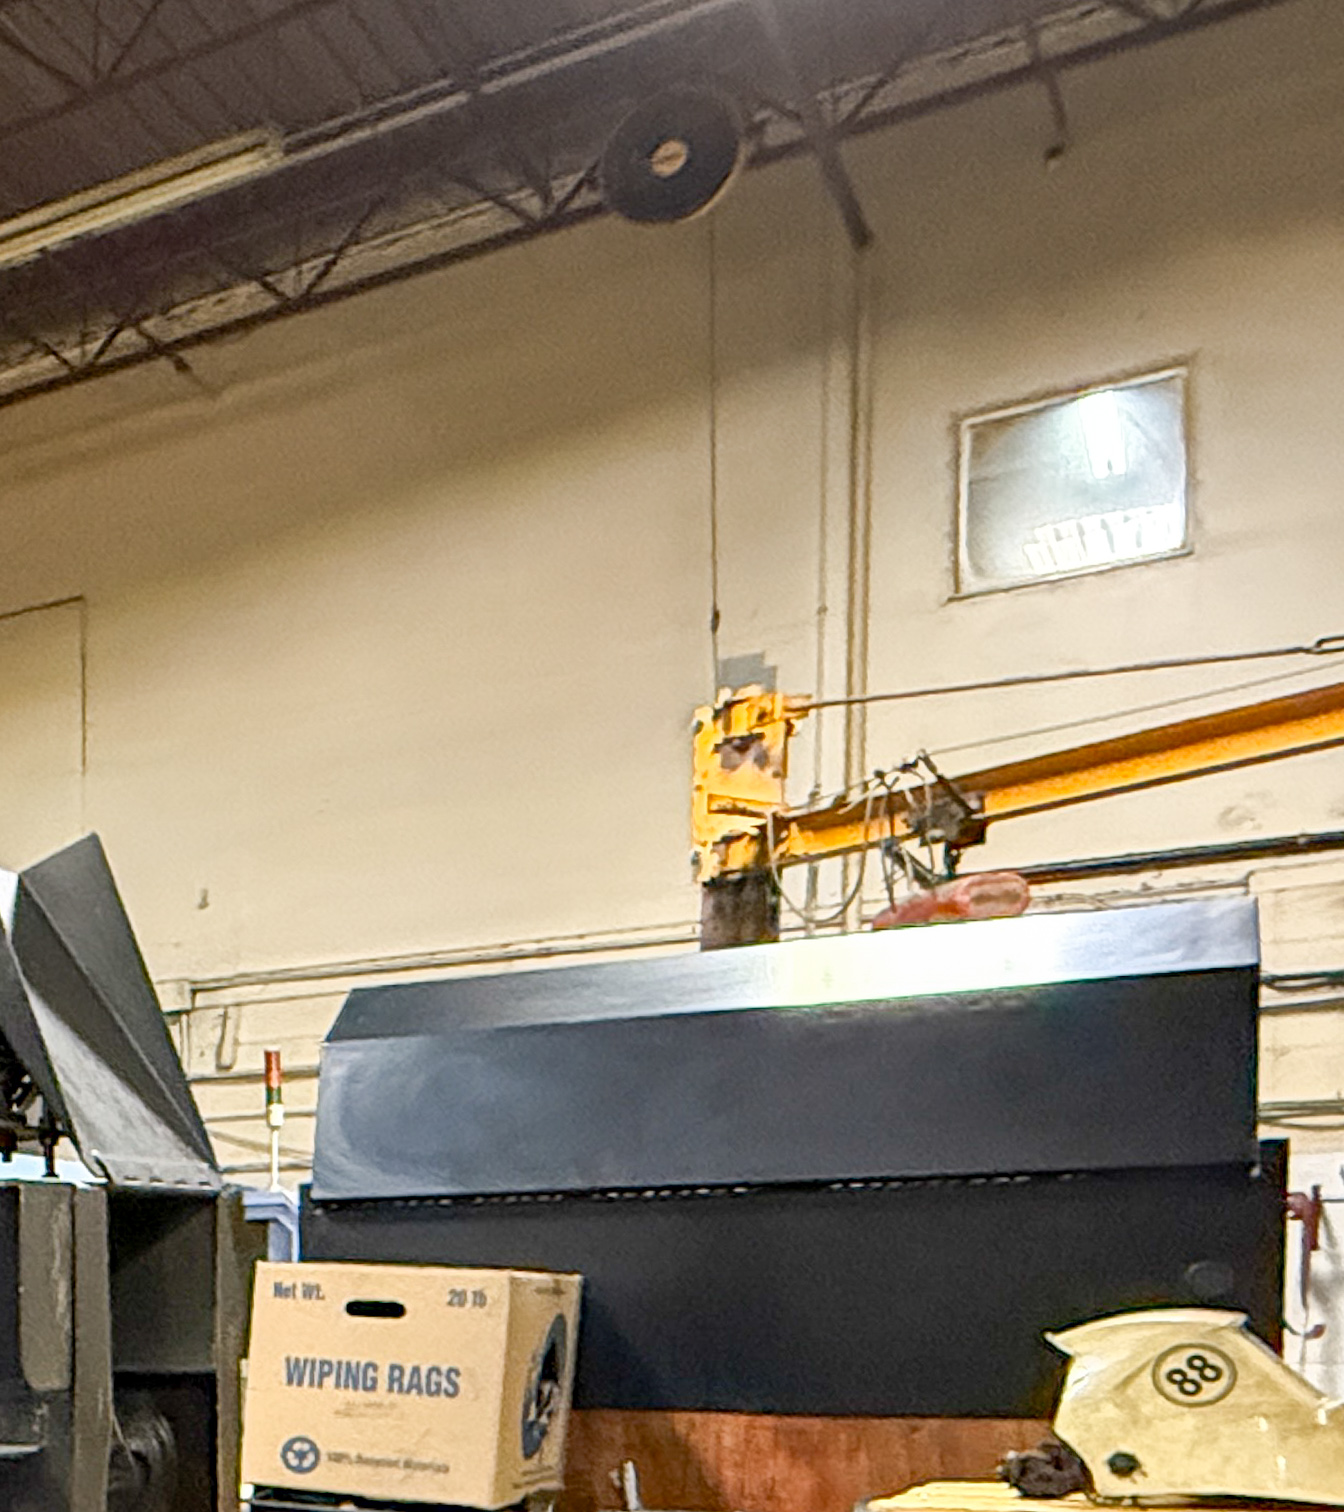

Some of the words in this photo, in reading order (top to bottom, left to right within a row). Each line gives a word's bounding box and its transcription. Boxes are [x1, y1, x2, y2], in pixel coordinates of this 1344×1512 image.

[284, 1355, 379, 1393] WIPING
[387, 1363, 462, 1398] RAGS
[1165, 1354, 1223, 1397] 88
